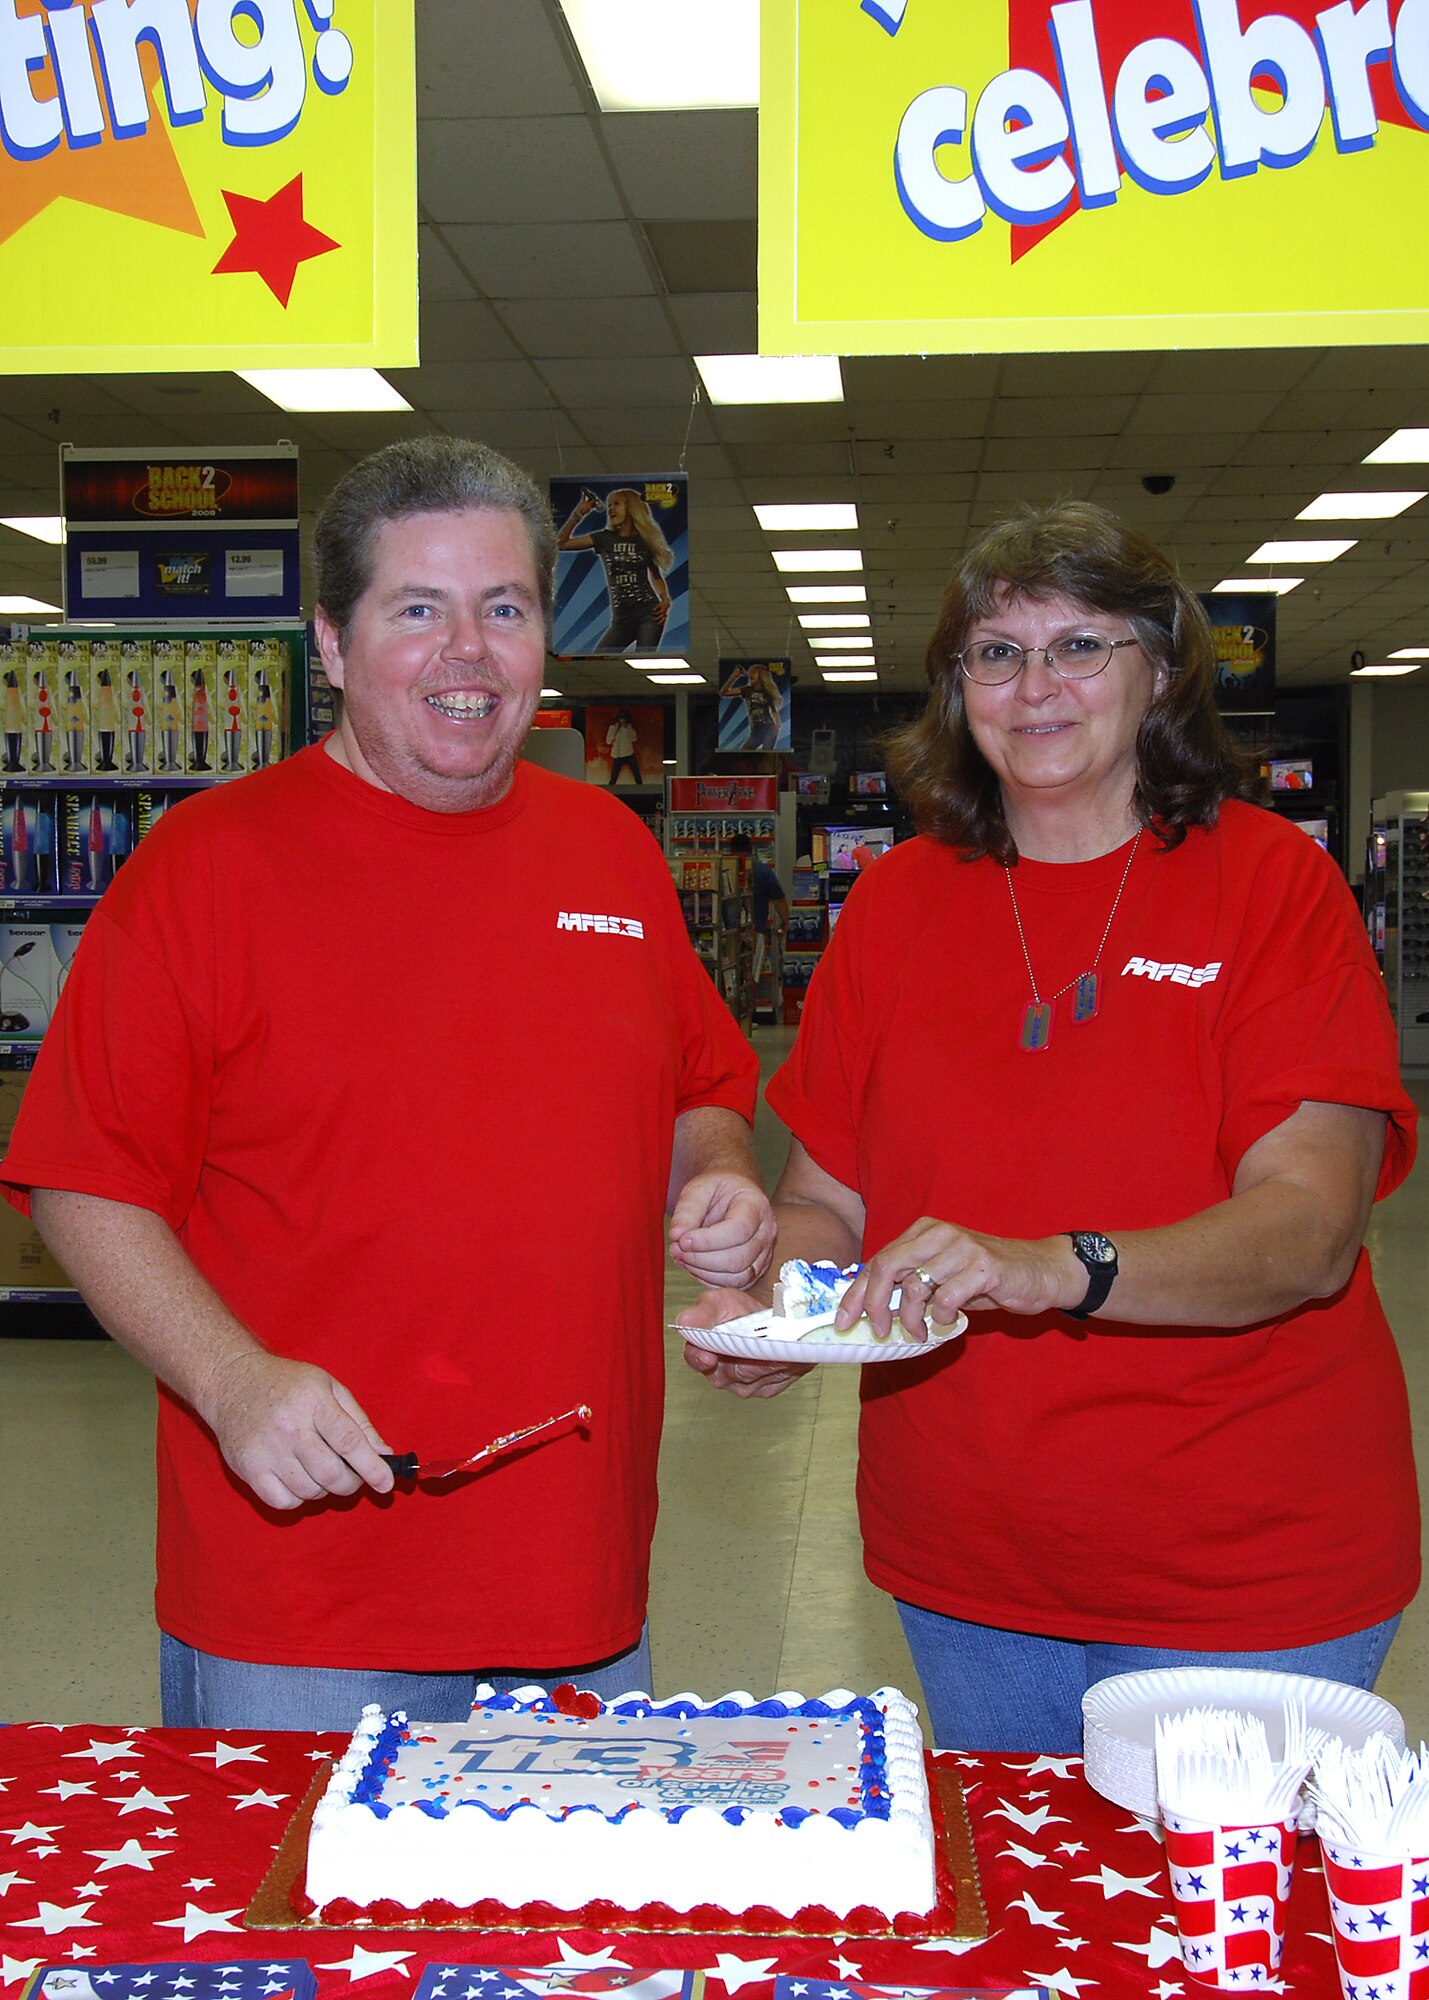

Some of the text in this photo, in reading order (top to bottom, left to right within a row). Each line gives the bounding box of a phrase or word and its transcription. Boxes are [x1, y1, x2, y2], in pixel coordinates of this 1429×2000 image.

[148, 489, 218, 510] SCHOOL
[164, 563, 202, 574] match
[636, 1766, 786, 1782] years
[617, 1779, 790, 1792] of service
[689, 1791, 786, 1801] value
